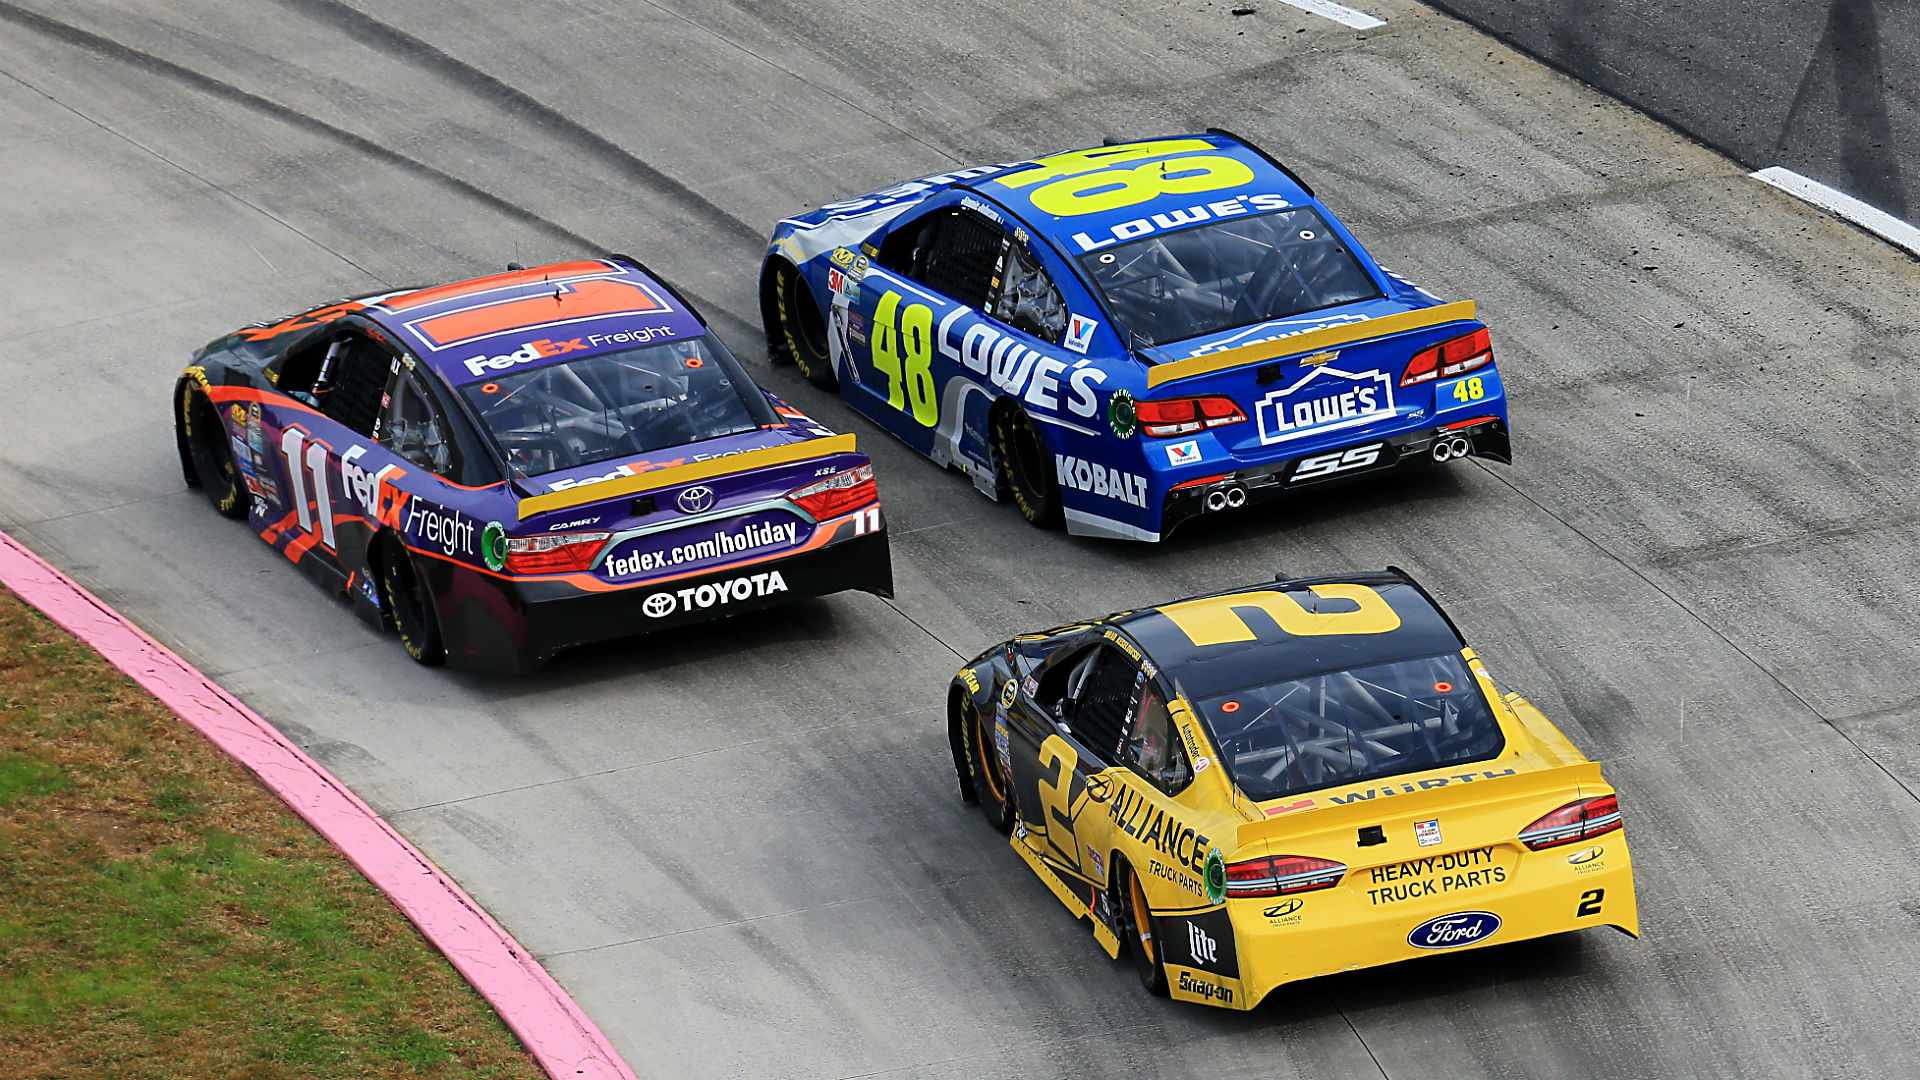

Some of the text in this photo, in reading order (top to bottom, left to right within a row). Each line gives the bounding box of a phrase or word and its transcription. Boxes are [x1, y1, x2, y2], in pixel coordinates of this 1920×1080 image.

[993, 138, 1256, 217] 48
[1071, 193, 1292, 252] LOWE'S
[829, 270, 844, 295] 3M
[463, 324, 676, 377] FedEx Freight
[872, 289, 938, 428] 48
[938, 305, 1108, 419] LOWE'S
[1109, 389, 1136, 414] AMERICAN
[1275, 385, 1378, 432] LOWE'S
[1453, 377, 1485, 403] 48
[1109, 420, 1136, 440] ETHANOL
[814, 466, 836, 477] XSE
[1055, 453, 1149, 509] KOBALT
[1289, 442, 1384, 482] SS
[281, 427, 337, 551] 11
[341, 444, 411, 530] FedEx
[404, 494, 475, 556] Freight
[549, 516, 601, 531] CAMRY
[852, 508, 882, 536] 11
[605, 521, 797, 578] fedex.com/holiday
[677, 570, 789, 612] TOYOTA
[1156, 583, 1401, 647] 2
[1182, 723, 1200, 759] Autotrader
[1038, 733, 1082, 874] 2
[1108, 783, 1210, 877] ALLIANCE
[1148, 859, 1178, 884] TRUCK
[1178, 872, 1204, 898] PARTS
[1371, 846, 1494, 884] HEAVY-DUTY
[1574, 861, 1605, 872] ALLIANCE
[1367, 866, 1506, 906] TRUCK PARTS
[1576, 888, 1605, 918] 2
[1269, 915, 1302, 924] ALLIANCE
[1427, 917, 1483, 948] Ford
[1186, 920, 1218, 965] Lite
[1178, 970, 1234, 1004] Snap-on
